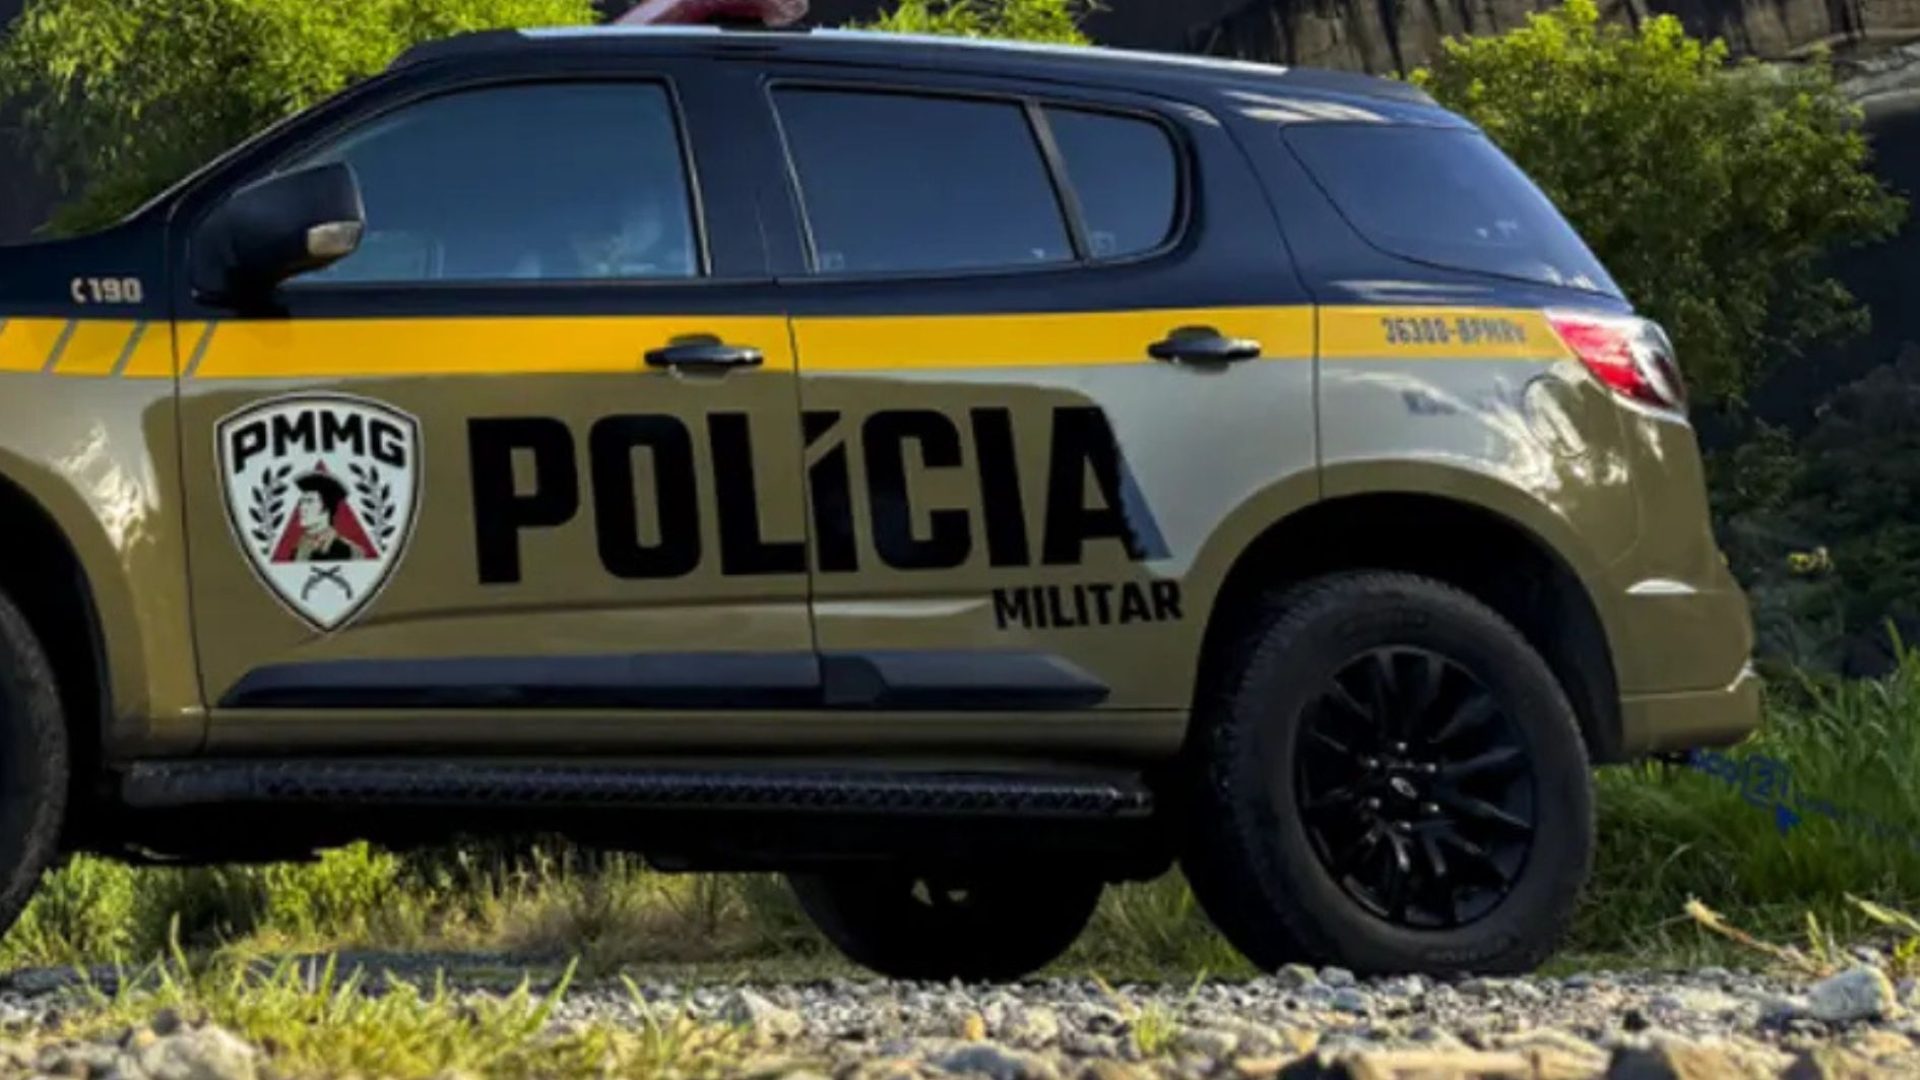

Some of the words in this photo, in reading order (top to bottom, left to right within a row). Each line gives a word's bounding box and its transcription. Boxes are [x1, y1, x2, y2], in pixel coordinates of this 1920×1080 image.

[87, 277, 142, 303] 190
[231, 410, 406, 474] PMMG
[467, 406, 1172, 585] POLÍCIA
[993, 578, 1183, 629] MILITAR
